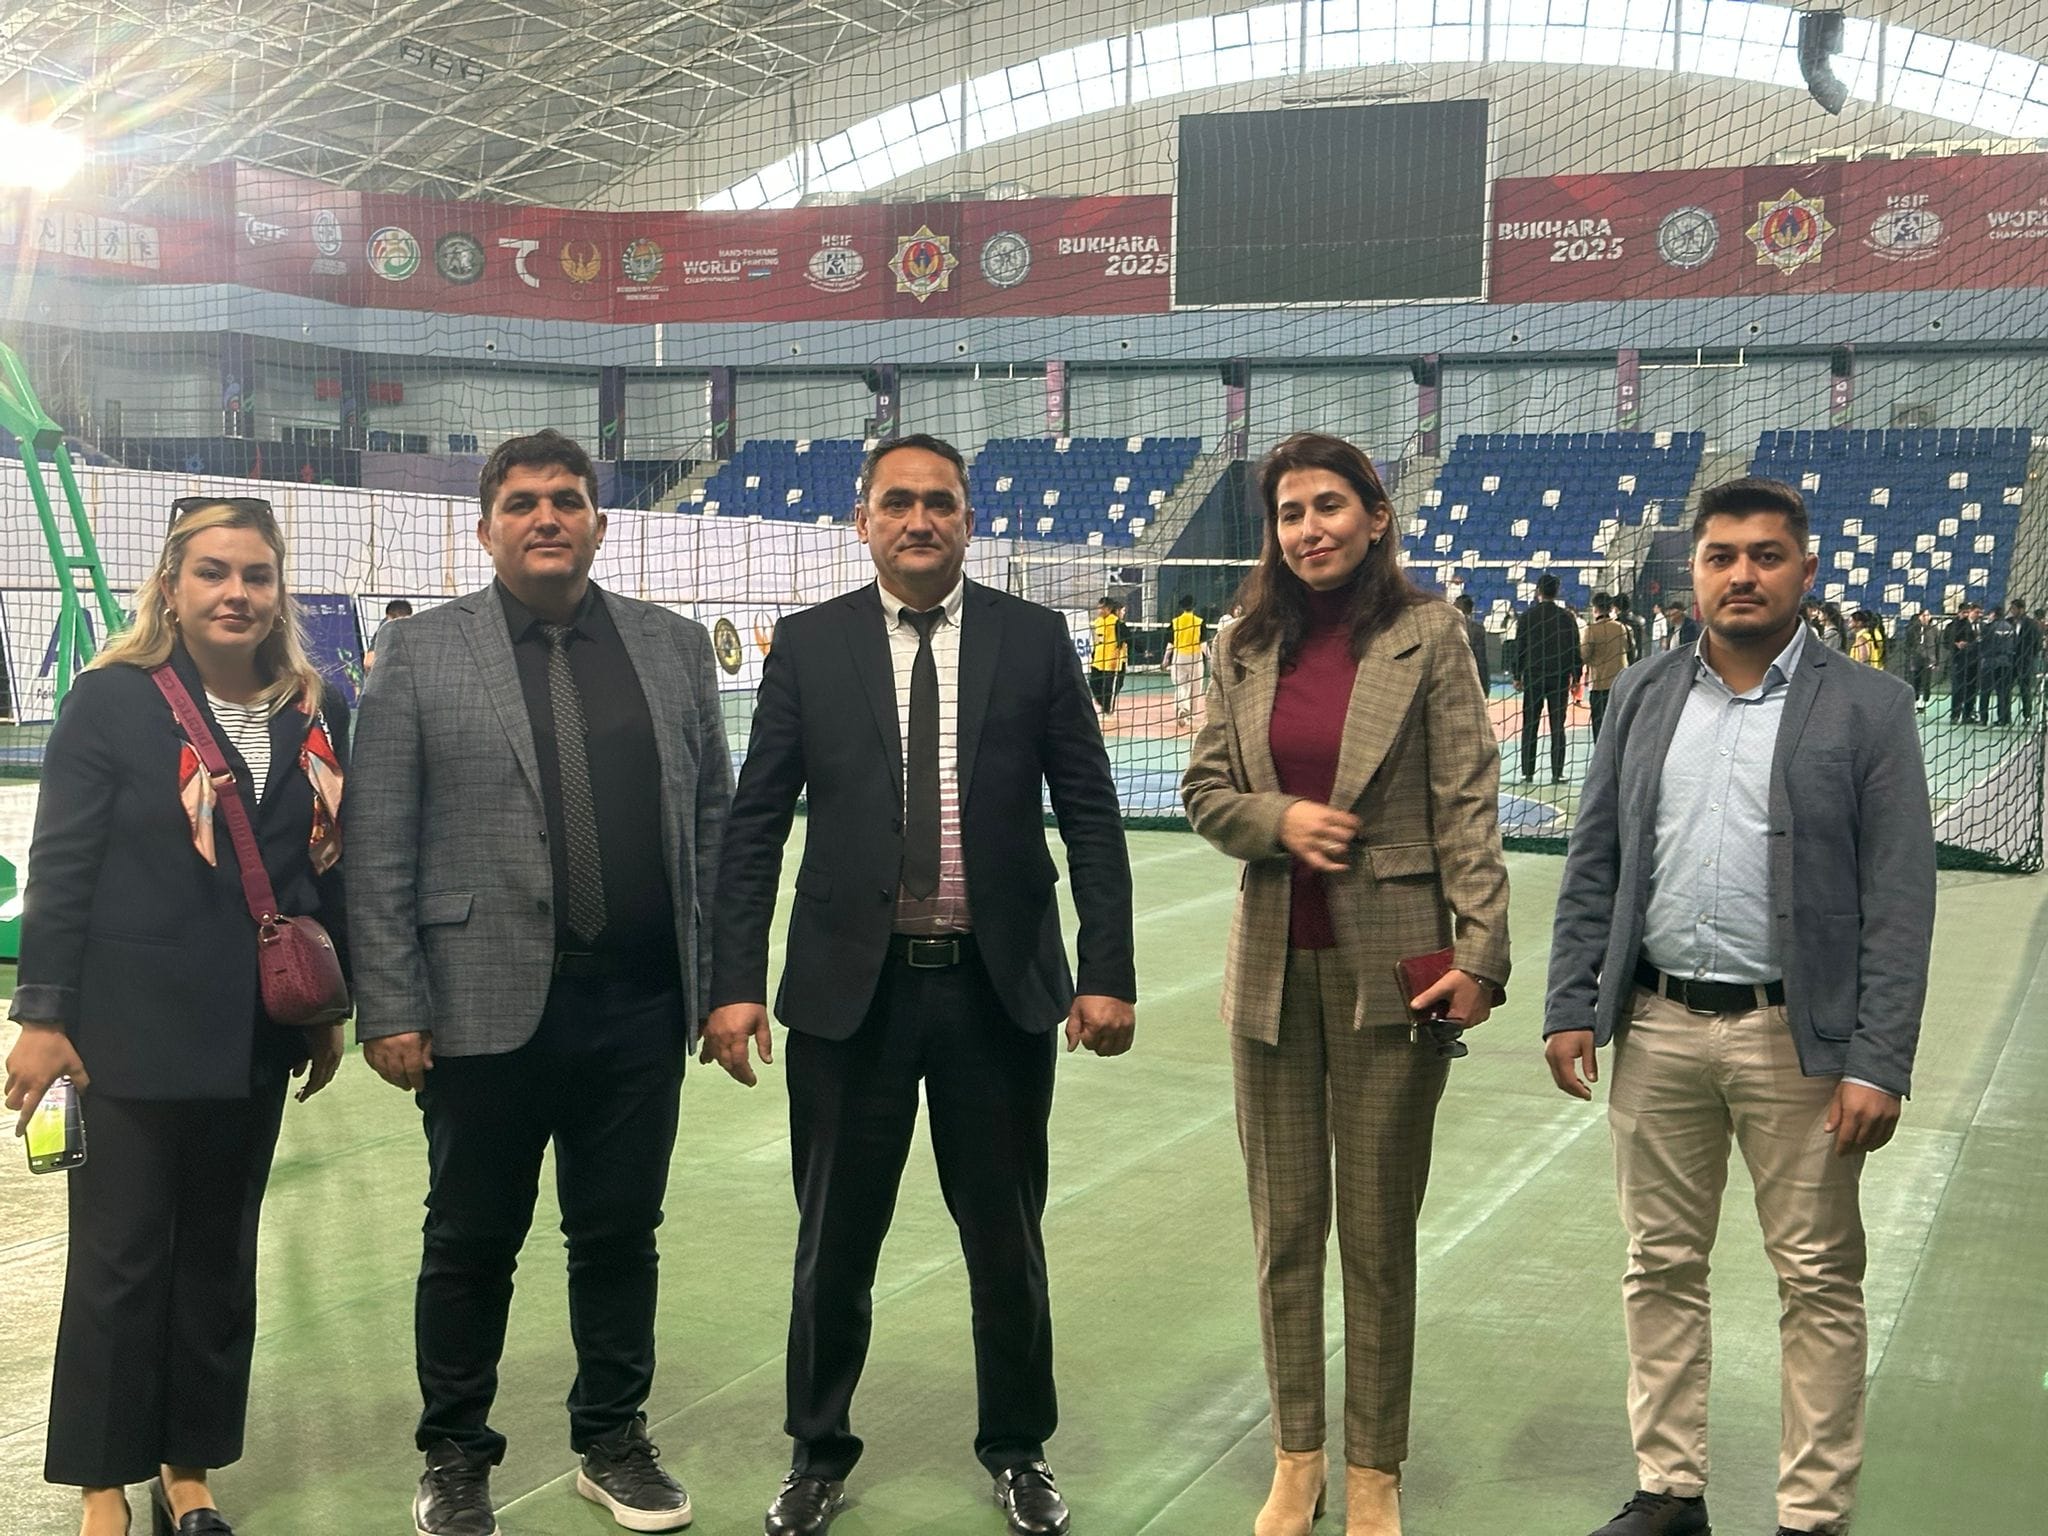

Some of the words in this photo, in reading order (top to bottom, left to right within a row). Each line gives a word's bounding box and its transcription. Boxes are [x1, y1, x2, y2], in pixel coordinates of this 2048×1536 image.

[1886, 194, 1930, 209] HSIF
[1497, 218, 1613, 241] BUKHARA
[821, 234, 853, 247] HSIF
[1058, 235, 1161, 255] BUKHARA
[1550, 237, 1626, 263] 2025
[682, 260, 742, 275] WORLD
[1104, 253, 1170, 277] 2025
